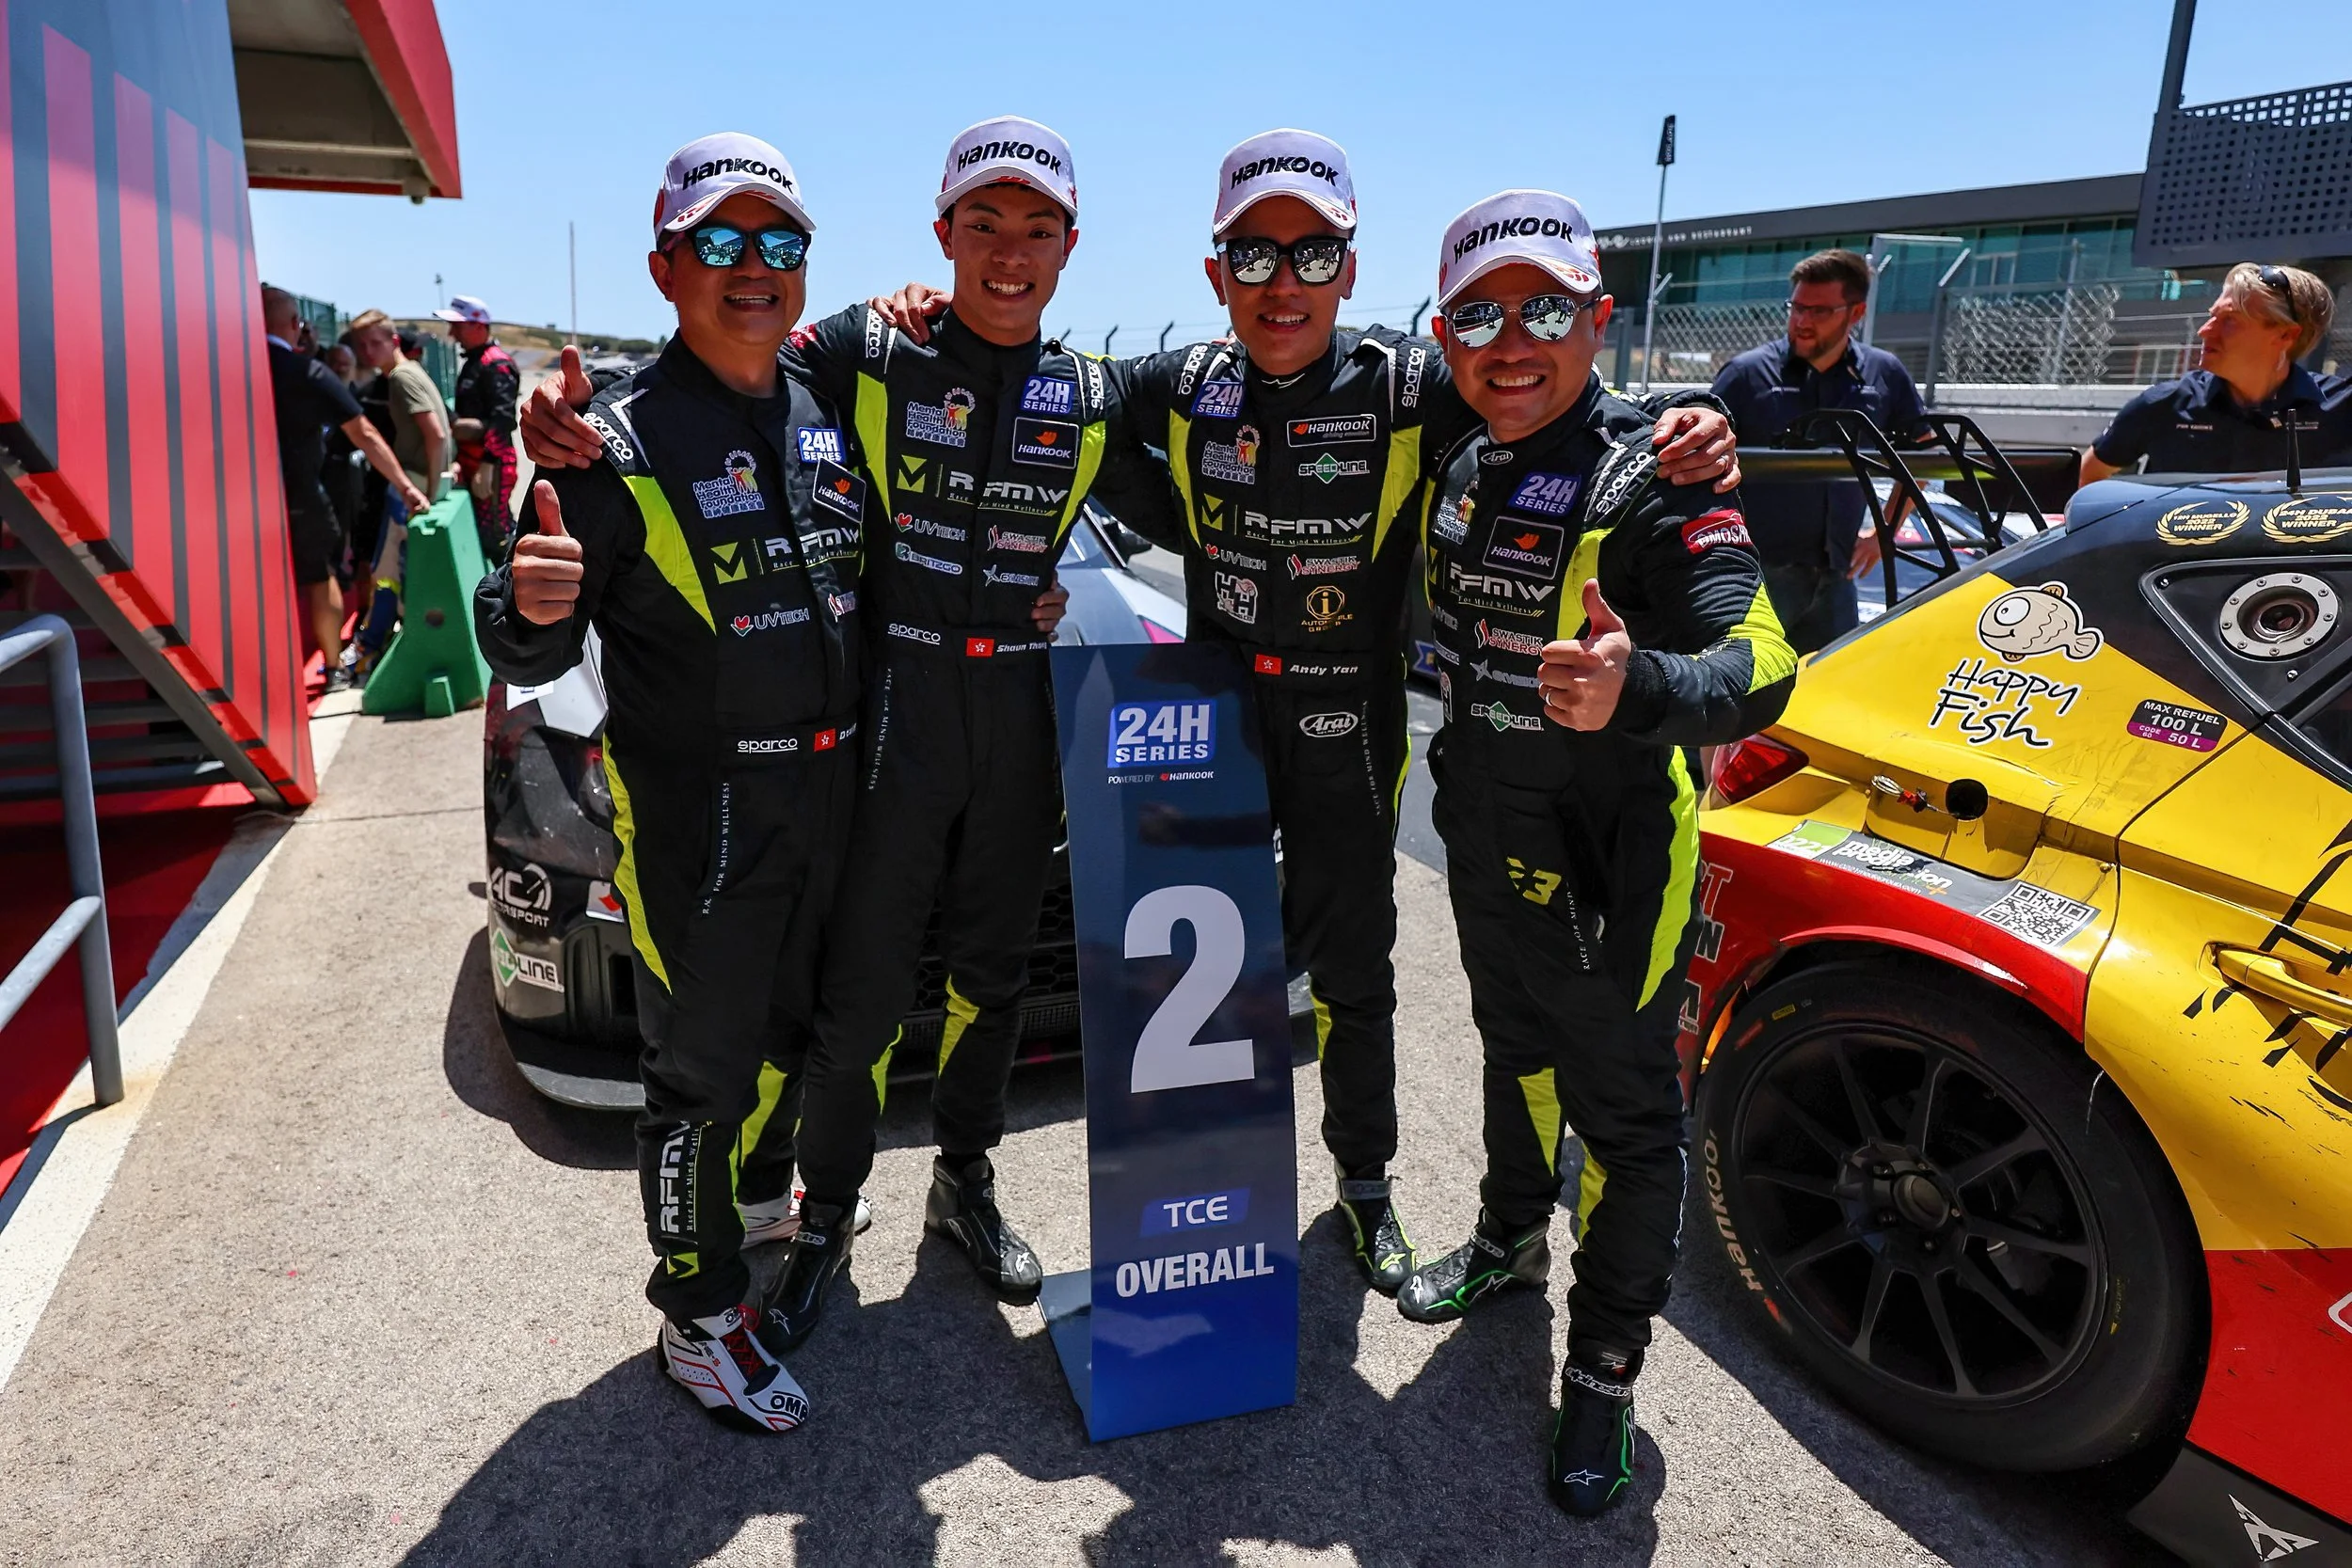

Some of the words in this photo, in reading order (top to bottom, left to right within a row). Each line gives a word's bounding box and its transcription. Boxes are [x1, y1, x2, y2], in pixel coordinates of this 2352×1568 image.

[866, 309, 882, 357] parco
[1178, 344, 1208, 395] sparco
[1401, 347, 1426, 408] sparco
[1025, 379, 1071, 404] 24H
[1200, 383, 1243, 405] 24H
[907, 402, 946, 417] Mental
[1024, 399, 1068, 414] SERIES
[1197, 404, 1238, 415] SERIES
[907, 420, 966, 439] Foundation
[908, 411, 944, 426] Health
[801, 431, 839, 452] 24H
[1205, 441, 1238, 454] Mental
[803, 451, 842, 461] SERIES
[693, 475, 734, 492] Mental
[695, 484, 737, 500] Health
[948, 471, 1069, 503] RFMW
[1521, 475, 1579, 503] 24H
[1596, 452, 1655, 515] sparco
[699, 492, 762, 509] Foundation
[1516, 497, 1566, 515] SERIES
[1245, 510, 1373, 535] RFMW
[2173, 523, 2223, 531] WINNER
[765, 528, 859, 557] RFMW
[997, 539, 1047, 553] SYNERGY
[1302, 561, 1361, 576] SYNERGY
[888, 623, 941, 645] sparco
[1492, 628, 1543, 646] SWASTIK
[997, 644, 1026, 653] Shaun
[1290, 664, 1327, 676] Andy
[1332, 666, 1359, 674] Yan
[1947, 659, 2081, 715] Happy
[1305, 714, 1352, 732] Arai
[1471, 703, 1544, 730] SPEEDLINE
[1931, 690, 2052, 746] Fish
[2144, 701, 2171, 714] MAX
[2173, 707, 2220, 725] REFUEL
[1117, 705, 1210, 746] 24H
[2139, 725, 2161, 735] CODE
[2151, 714, 2186, 731] 100
[2190, 722, 2201, 736] L
[738, 738, 798, 753] sparco
[2168, 732, 2188, 745] 50
[2191, 737, 2201, 749] L
[1116, 743, 1209, 763] SERIES
[1108, 774, 1144, 784] POWERED
[1145, 774, 1154, 783] BY
[722, 783, 730, 835] WELLNESS
[720, 839, 728, 867] MIND
[1845, 840, 1915, 867] media
[1580, 946, 1591, 970] RACE
[1124, 884, 1255, 1093] 2
[1163, 1195, 1228, 1228] TCE
[1703, 1129, 1763, 1291] Hankoo
[1115, 1243, 1274, 1298] OVERALL
